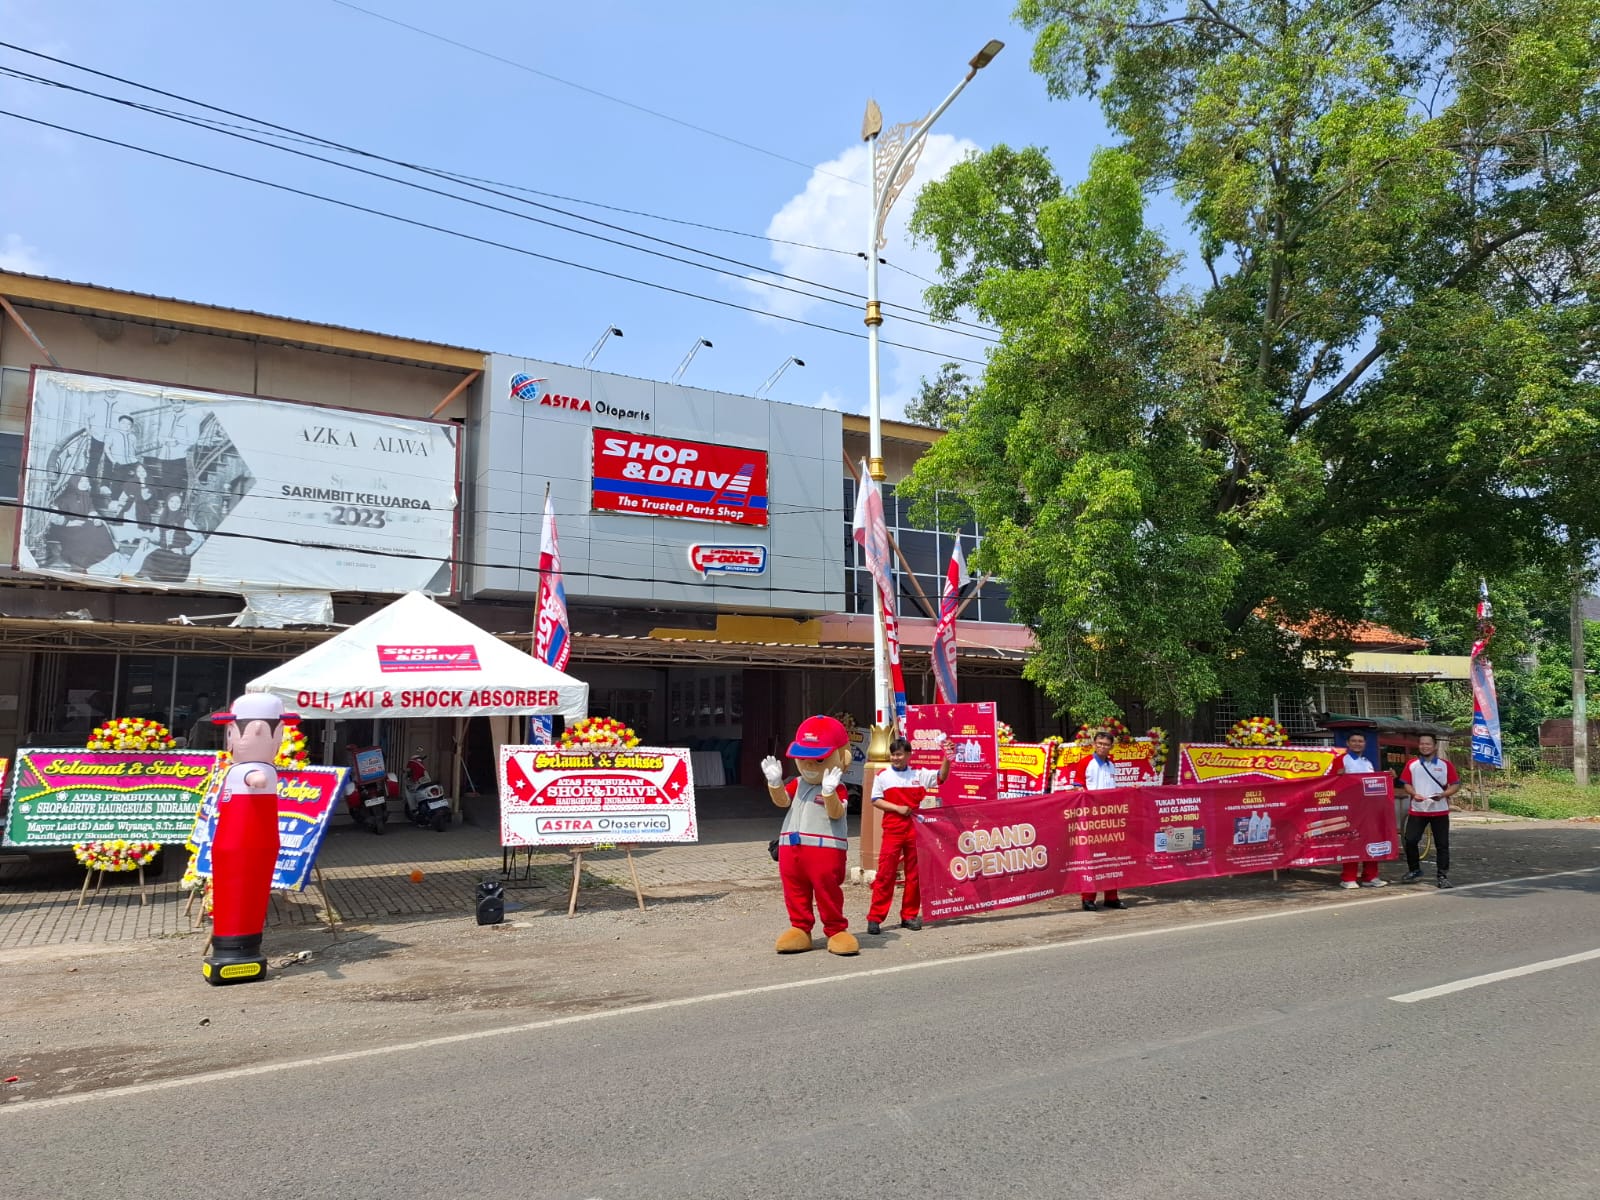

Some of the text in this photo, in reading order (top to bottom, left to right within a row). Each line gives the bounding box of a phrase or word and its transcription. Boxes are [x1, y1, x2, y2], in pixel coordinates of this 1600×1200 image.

[540, 393, 650, 420] ASTRA Otoparts
[299, 426, 428, 457] AZKA ALWA
[602, 438, 698, 465] SHOP
[281, 485, 431, 510] SARIMBIT KELUARGA
[618, 496, 744, 520] The Trusted Parts Shop
[329, 505, 386, 529] 2023
[297, 690, 559, 712] OLI, AKI & SHOCK ABSORBER
[44, 759, 208, 778] Selamat & Sukses
[535, 753, 664, 770] Selamat & Sukses
[1196, 752, 1320, 772] Selamat & Sukses
[556, 778, 644, 786] ATAS PEMBUKAAN
[72, 793, 176, 802] ATAS PEMBUKAAN
[547, 785, 657, 798] SHOP&DRIVE
[98, 802, 152, 814] HAURGEULIS
[156, 802, 200, 814] INDRAMAY
[1155, 797, 1201, 806] TUKAR TAMBAH
[1063, 804, 1128, 820] SHOP & DRIVE
[27, 822, 55, 834] Mayor
[542, 818, 667, 831] ASTRA Otoservice
[1068, 818, 1126, 832] HAURGEULIS
[957, 823, 1036, 854] GRAND
[1069, 832, 1125, 847] INDRAMAYU
[949, 845, 1048, 880] OPENING
[931, 907, 952, 916] OUTLET
